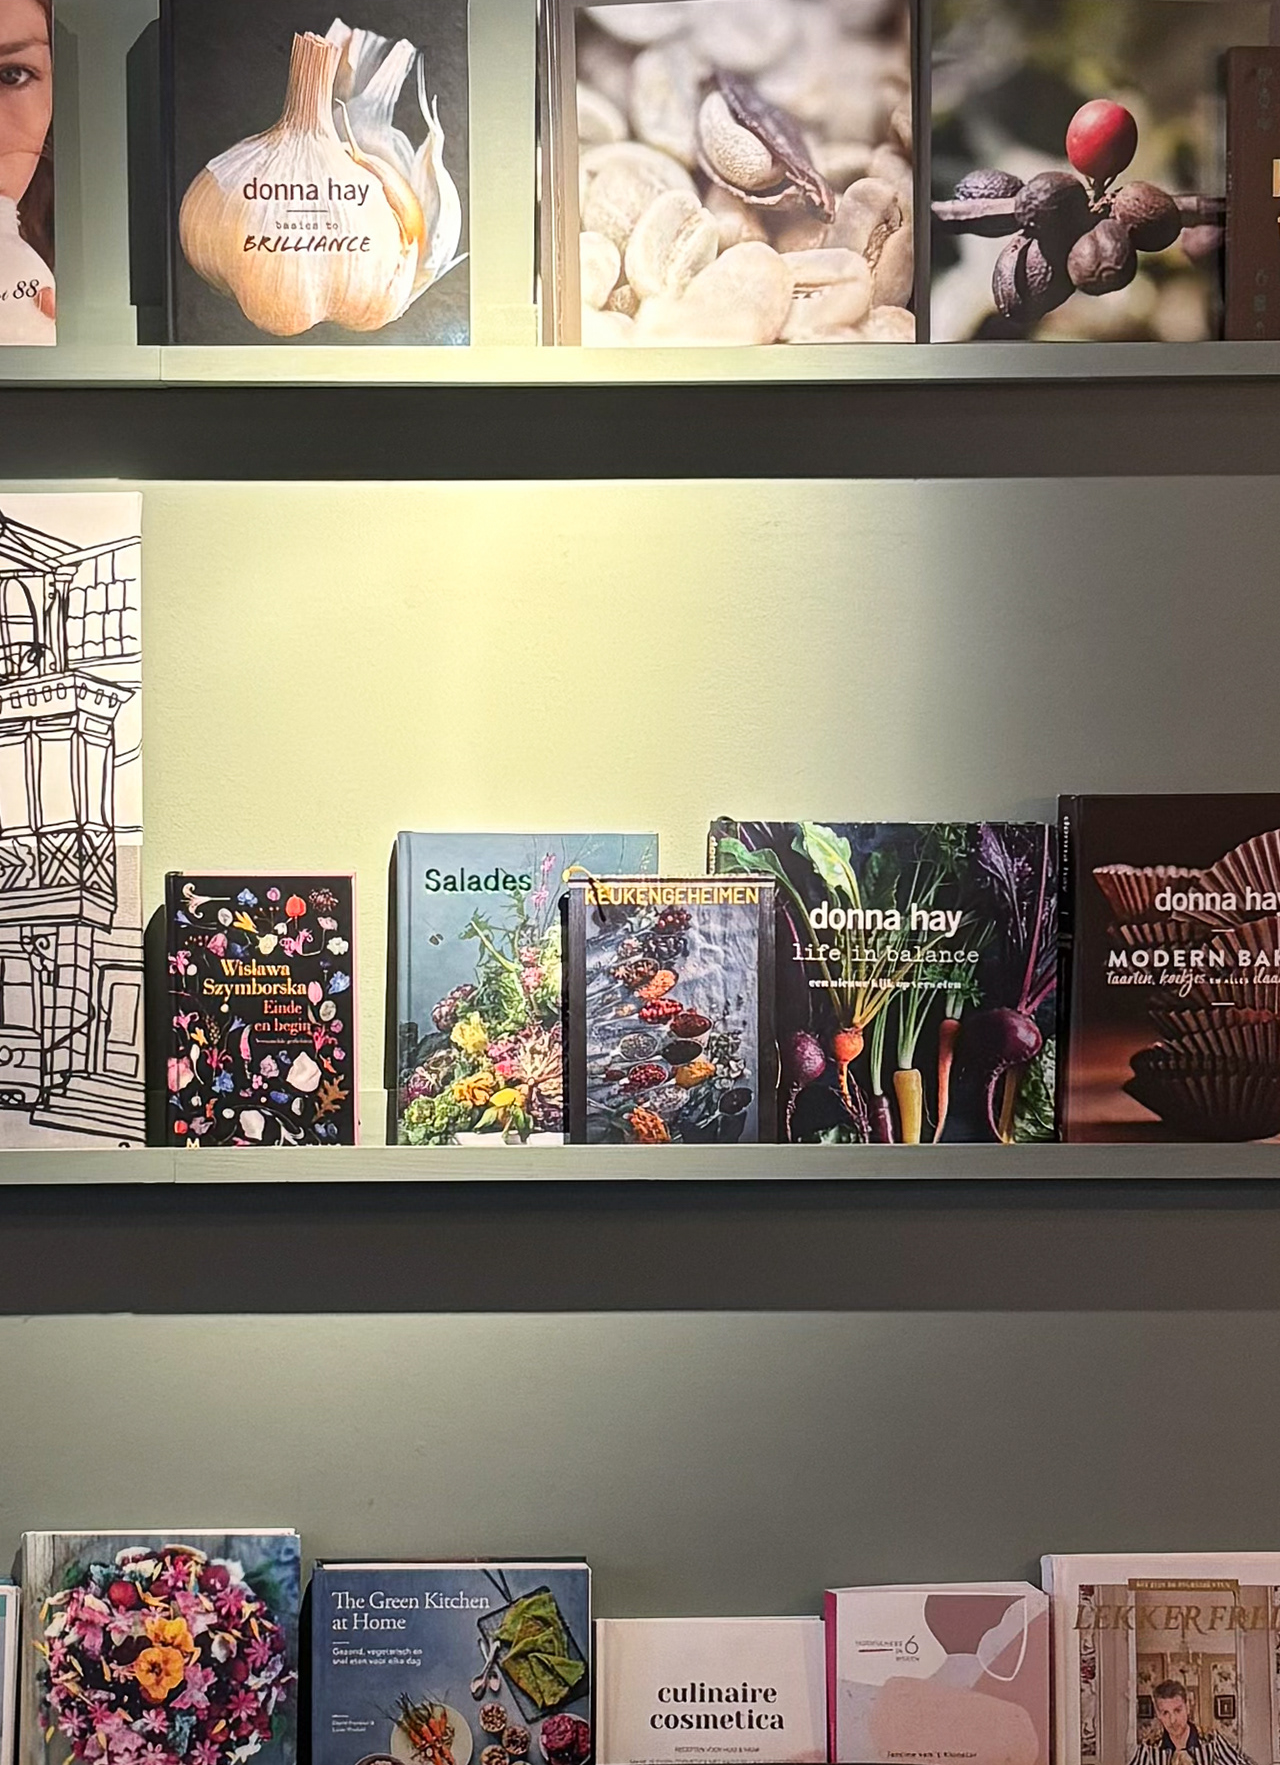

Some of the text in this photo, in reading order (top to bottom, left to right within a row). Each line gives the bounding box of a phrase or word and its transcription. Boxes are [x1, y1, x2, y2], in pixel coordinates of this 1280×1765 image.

[242, 177, 370, 207] donna hay
[242, 234, 372, 254] BRILLIANCE
[12, 278, 40, 300] 88
[424, 867, 532, 894] Salades
[583, 886, 760, 906] KEUKENGEHEIMEN
[1155, 886, 1237, 912] donna
[809, 901, 964, 938] donna hay
[792, 942, 980, 963] life in balance
[1108, 949, 1225, 968] MODERN
[202, 977, 308, 1001] Szymborska
[263, 999, 303, 1015] Einde
[253, 1018, 313, 1036] en begin
[331, 1590, 491, 1610] The Green Kitchen
[331, 1614, 407, 1631] at Home
[1072, 1604, 1209, 1636] LEKKER
[657, 1681, 778, 1705] culinaire
[649, 1709, 785, 1731] cosmetica
